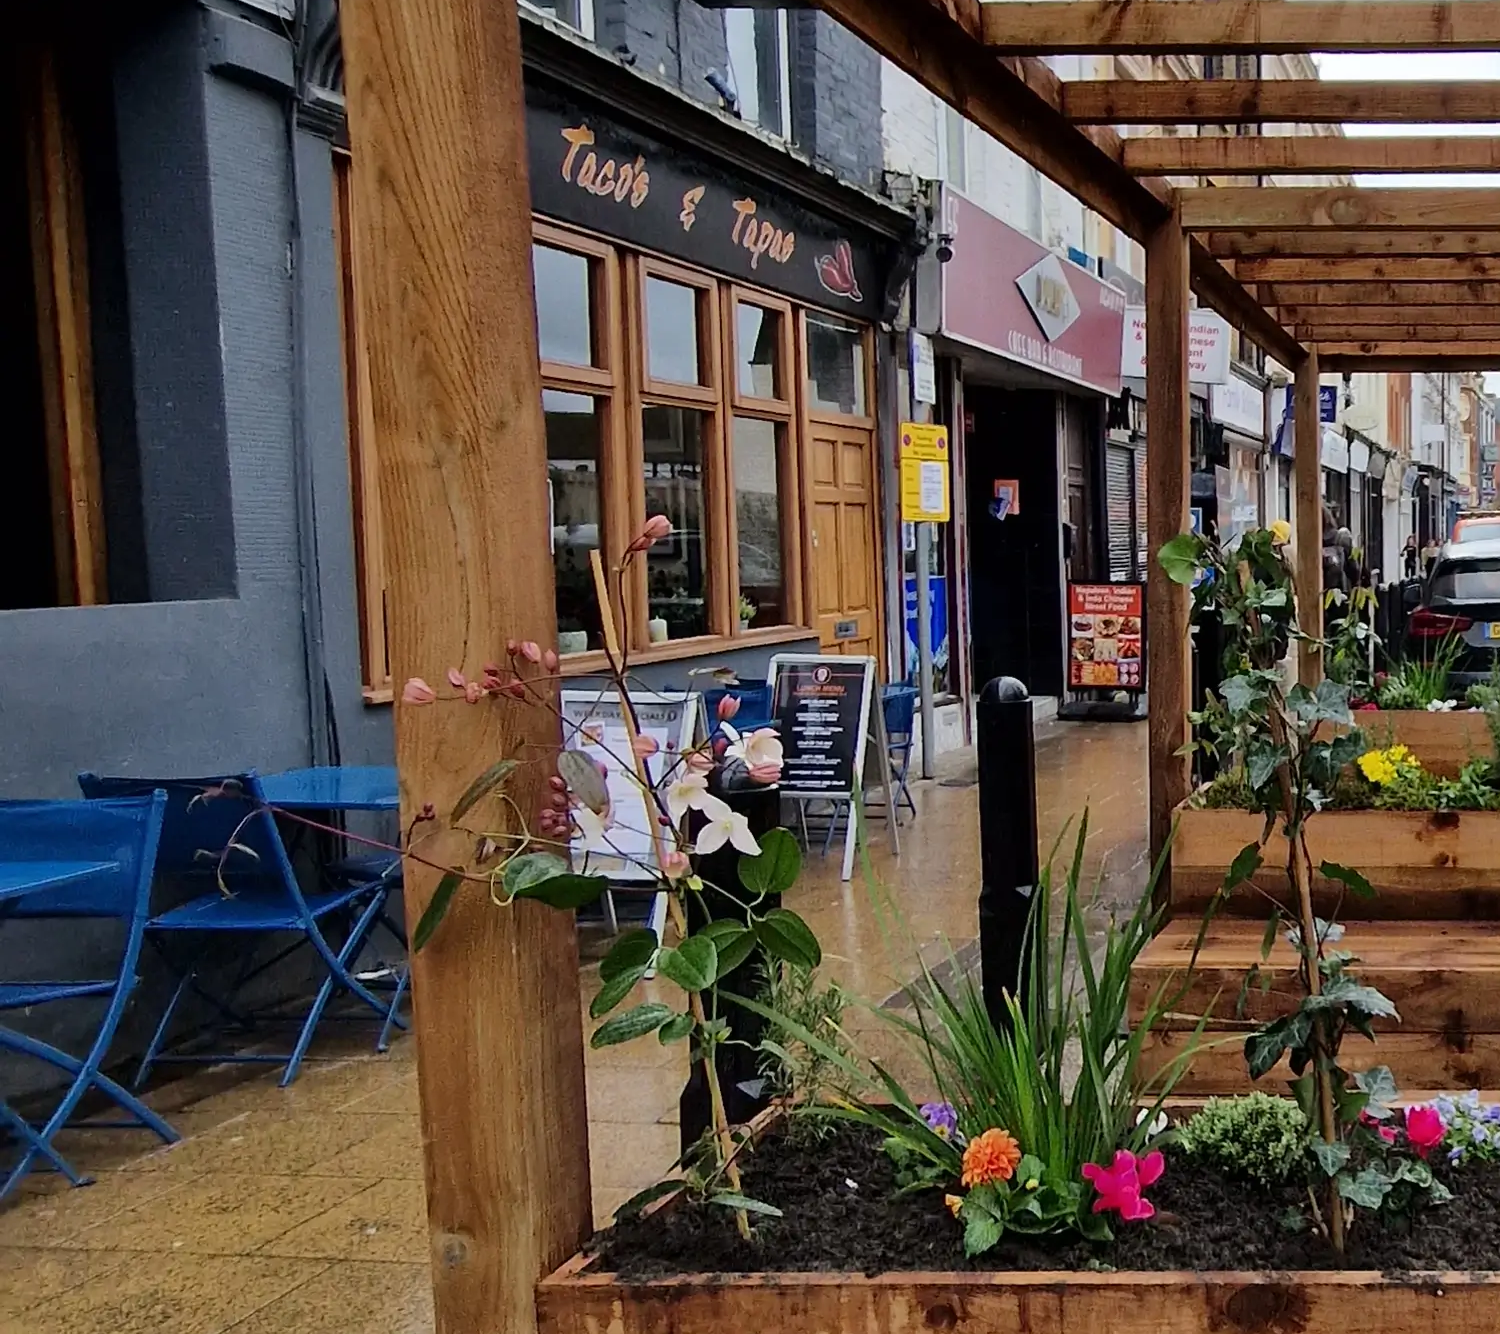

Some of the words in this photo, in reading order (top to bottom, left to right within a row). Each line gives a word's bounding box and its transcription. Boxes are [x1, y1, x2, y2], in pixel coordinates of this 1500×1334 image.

[560, 123, 650, 209] Taco's
[731, 197, 796, 270] Tapas
[1190, 325, 1219, 335] ndian
